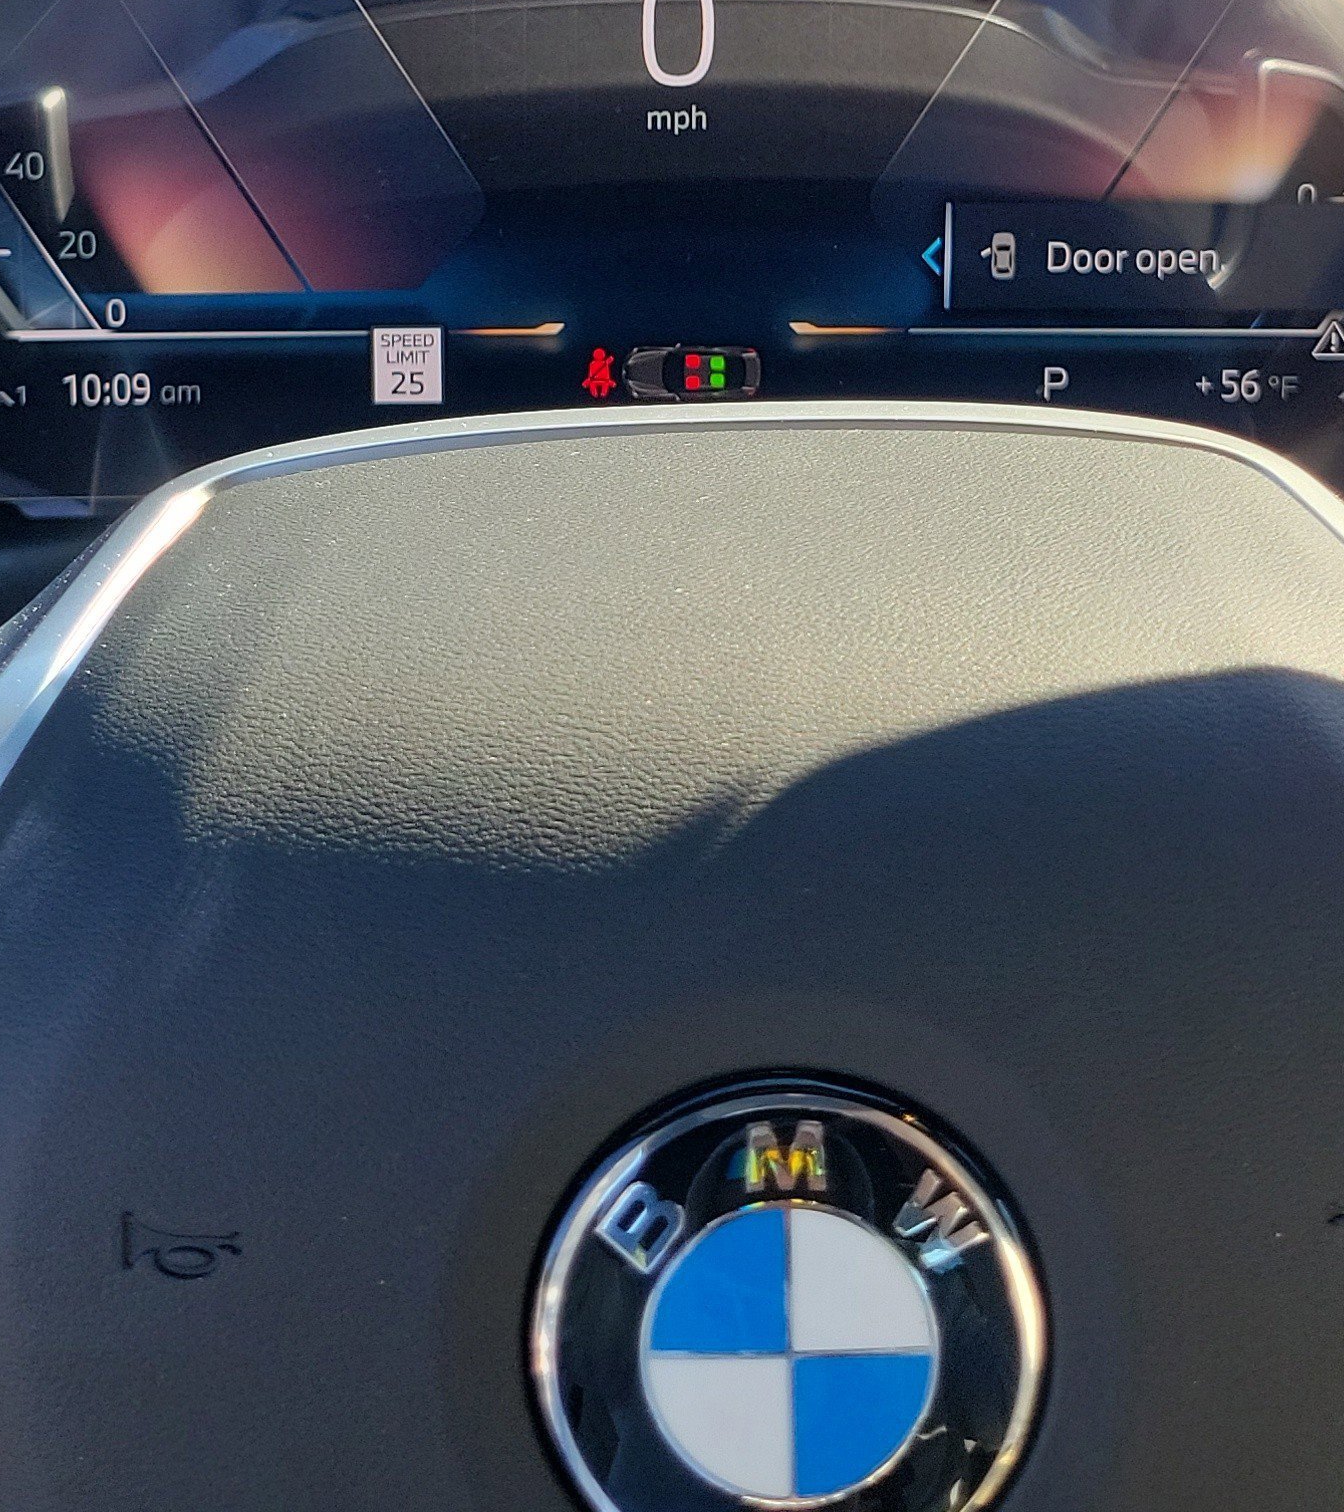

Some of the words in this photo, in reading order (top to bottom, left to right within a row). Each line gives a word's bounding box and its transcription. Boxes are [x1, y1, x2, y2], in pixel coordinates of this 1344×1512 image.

[646, 104, 709, 135] mph
[5, 151, 45, 181] 40
[58, 230, 97, 260] 20
[1047, 240, 1129, 275] Door
[105, 297, 127, 329] 0
[380, 332, 435, 348] SPEED
[385, 349, 431, 365] LIMIT
[61, 372, 152, 407] 10:09
[160, 382, 202, 406] am
[390, 371, 426, 396] 25
[1042, 366, 1069, 403] P
[594, 1120, 991, 1276] BMW
